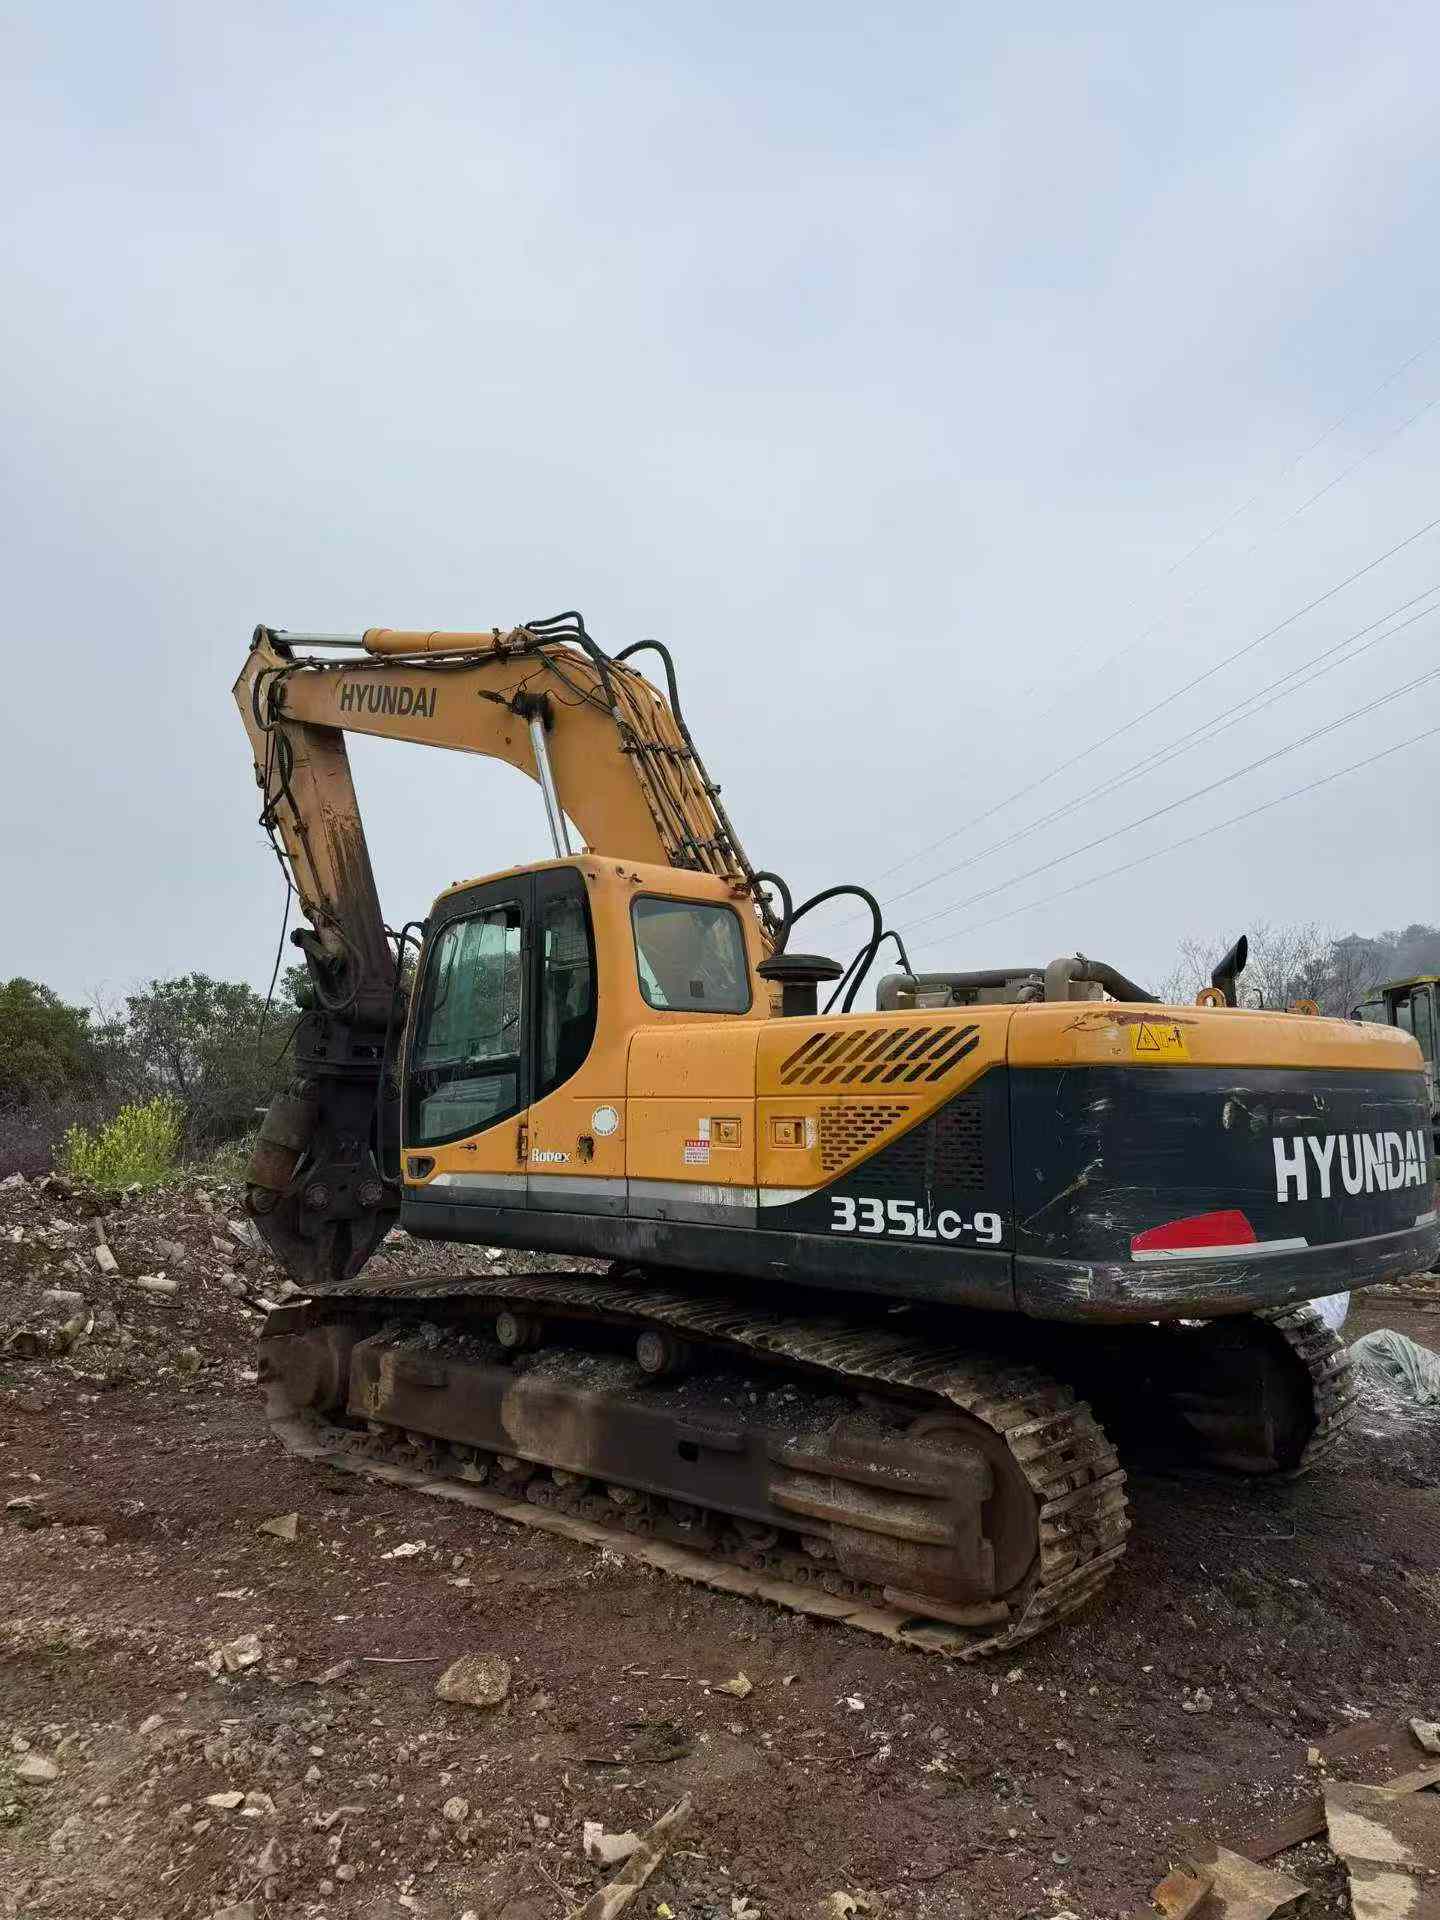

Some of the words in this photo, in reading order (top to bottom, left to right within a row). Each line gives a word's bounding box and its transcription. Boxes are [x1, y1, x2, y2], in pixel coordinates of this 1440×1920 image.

[340, 683, 438, 718] HYUNDAI
[1272, 1130, 1428, 1203] HYUNDAI
[831, 1196, 1002, 1244] 335LC-9
